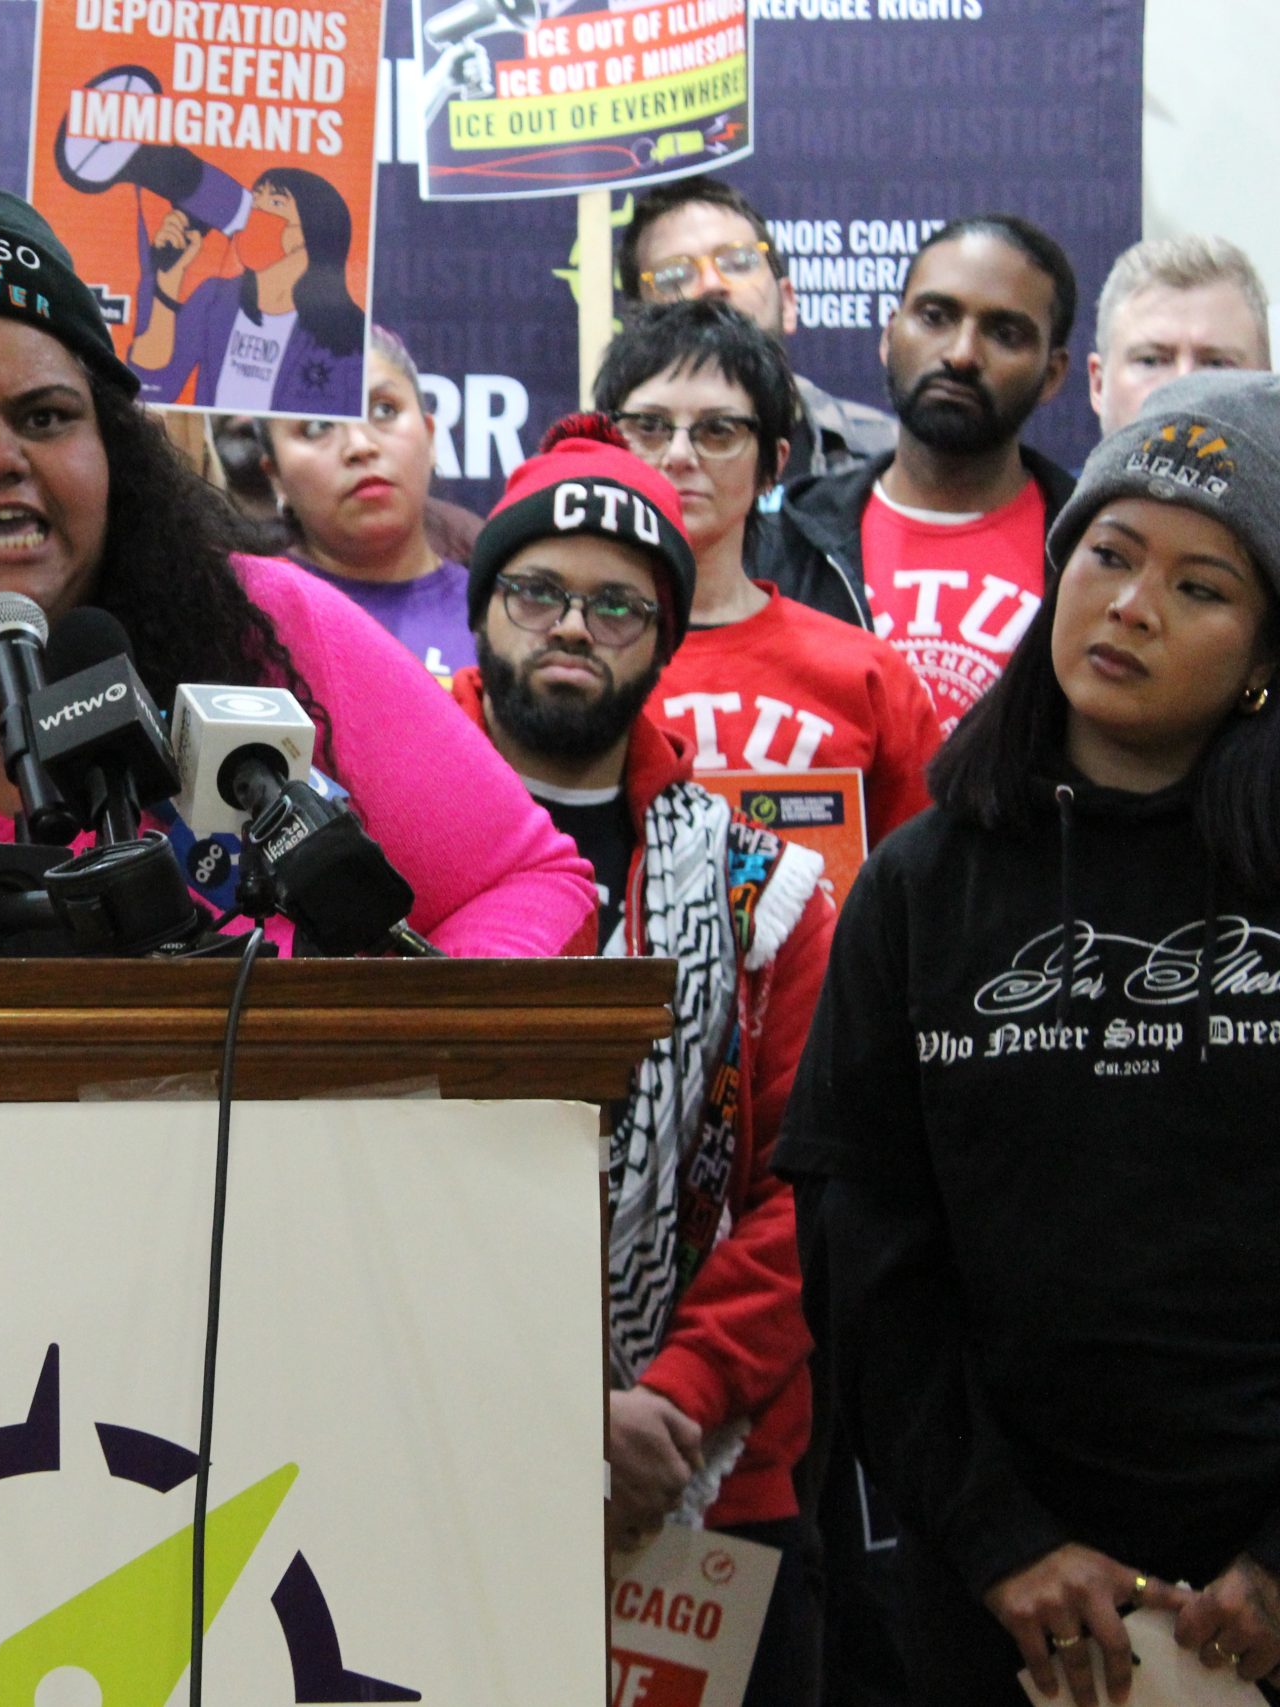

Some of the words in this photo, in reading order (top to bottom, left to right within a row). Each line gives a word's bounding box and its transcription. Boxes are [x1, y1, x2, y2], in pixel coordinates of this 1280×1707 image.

[75, 0, 348, 51] DEPORTATIONS
[527, 26, 570, 58] ICE
[577, 19, 627, 53] OUT
[632, 11, 663, 43] OF
[172, 42, 346, 103] DEFEND
[498, 68, 542, 98] ICE
[549, 61, 599, 92] OUT
[605, 54, 636, 85] OF
[642, 26, 746, 80] MINNESOTA
[68, 89, 344, 157] IMMIGRANTS
[456, 112, 495, 138] ICE
[509, 108, 558, 135] OUT
[571, 102, 600, 130] OF
[553, 482, 661, 546] CTU
[195, 843, 223, 884] abc
[983, 1021, 1091, 1058] Never
[1103, 1018, 1185, 1051] Stop
